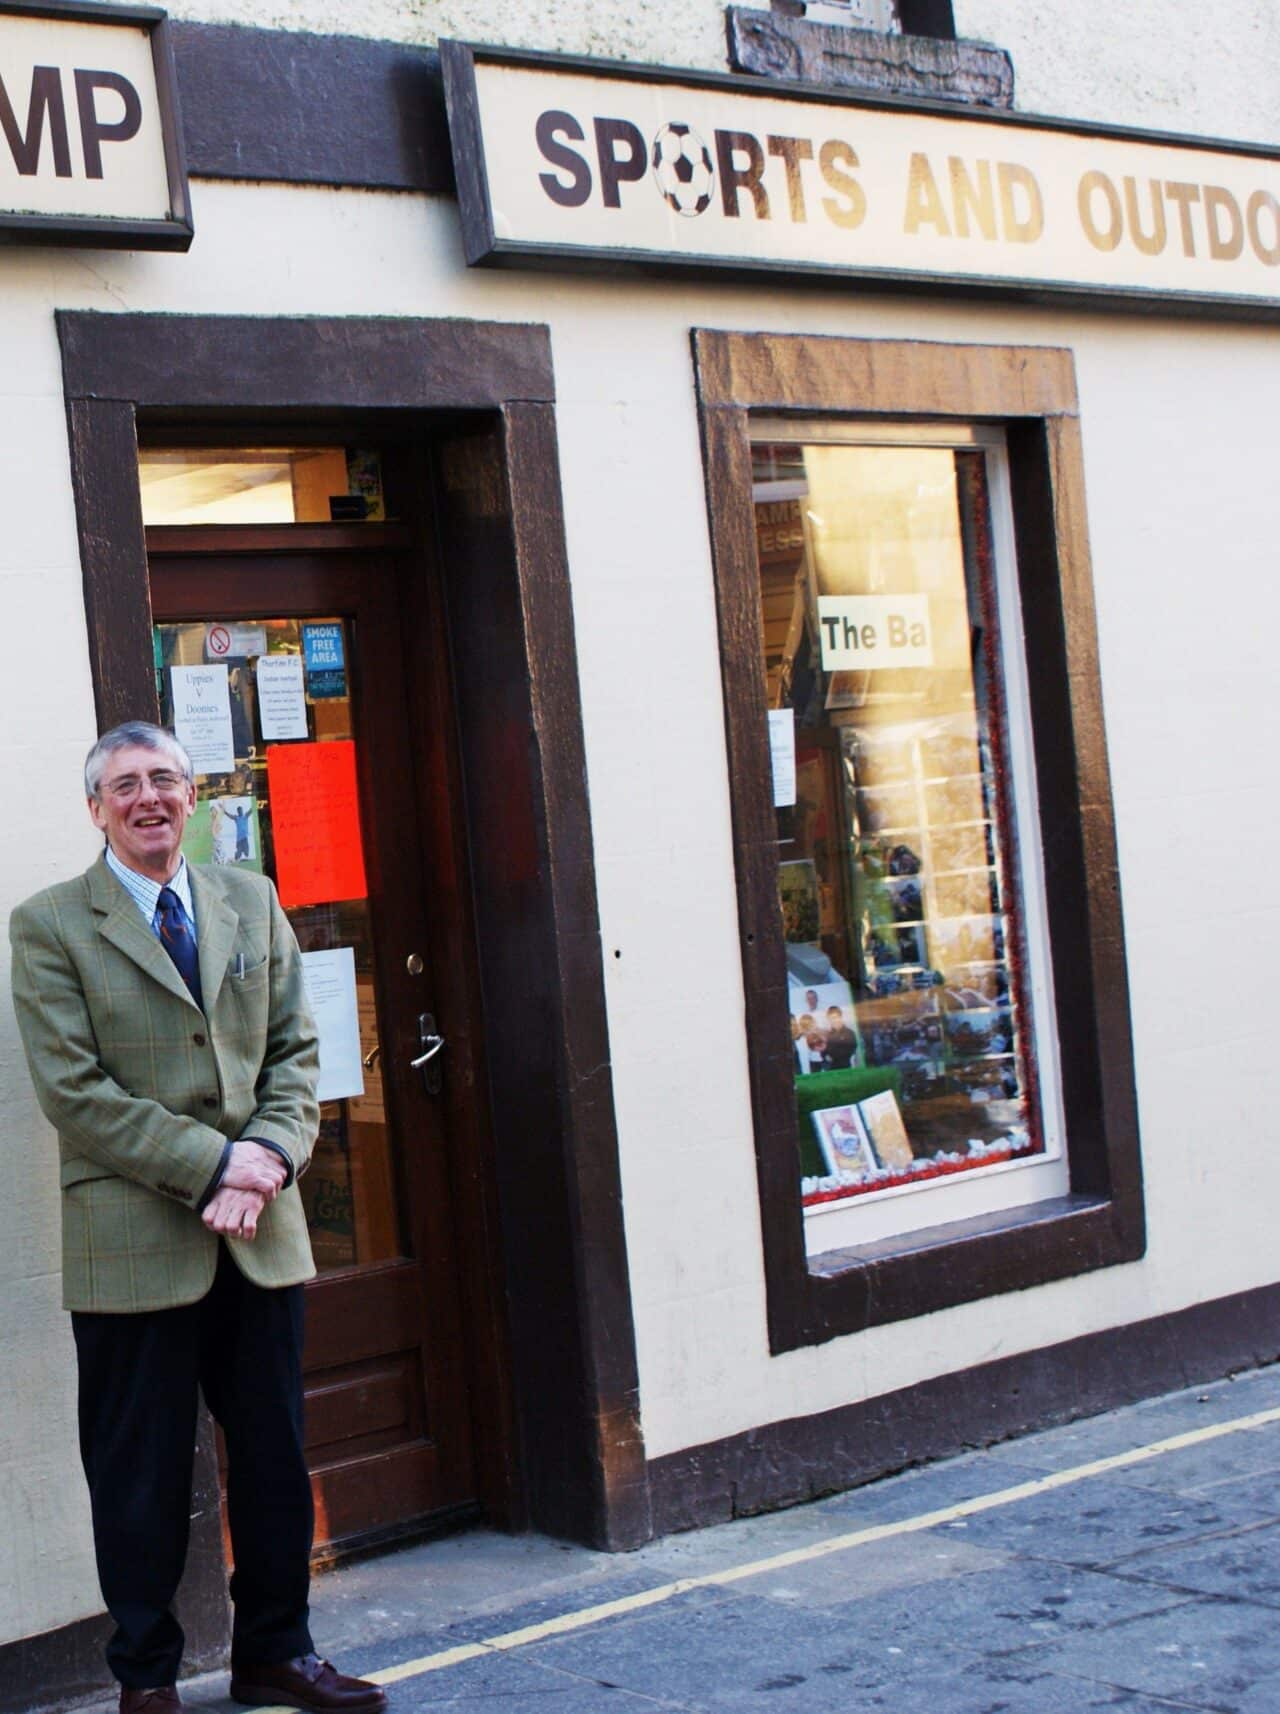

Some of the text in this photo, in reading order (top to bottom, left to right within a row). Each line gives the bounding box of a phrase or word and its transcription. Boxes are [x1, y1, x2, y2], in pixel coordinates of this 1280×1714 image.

[903, 152, 1045, 245] AND
[1077, 169, 1280, 267] OUTDO
[306, 626, 339, 639] SMOKE
[821, 614, 928, 650] The Ba
[312, 639, 335, 651] FREE
[312, 652, 338, 664] AREA
